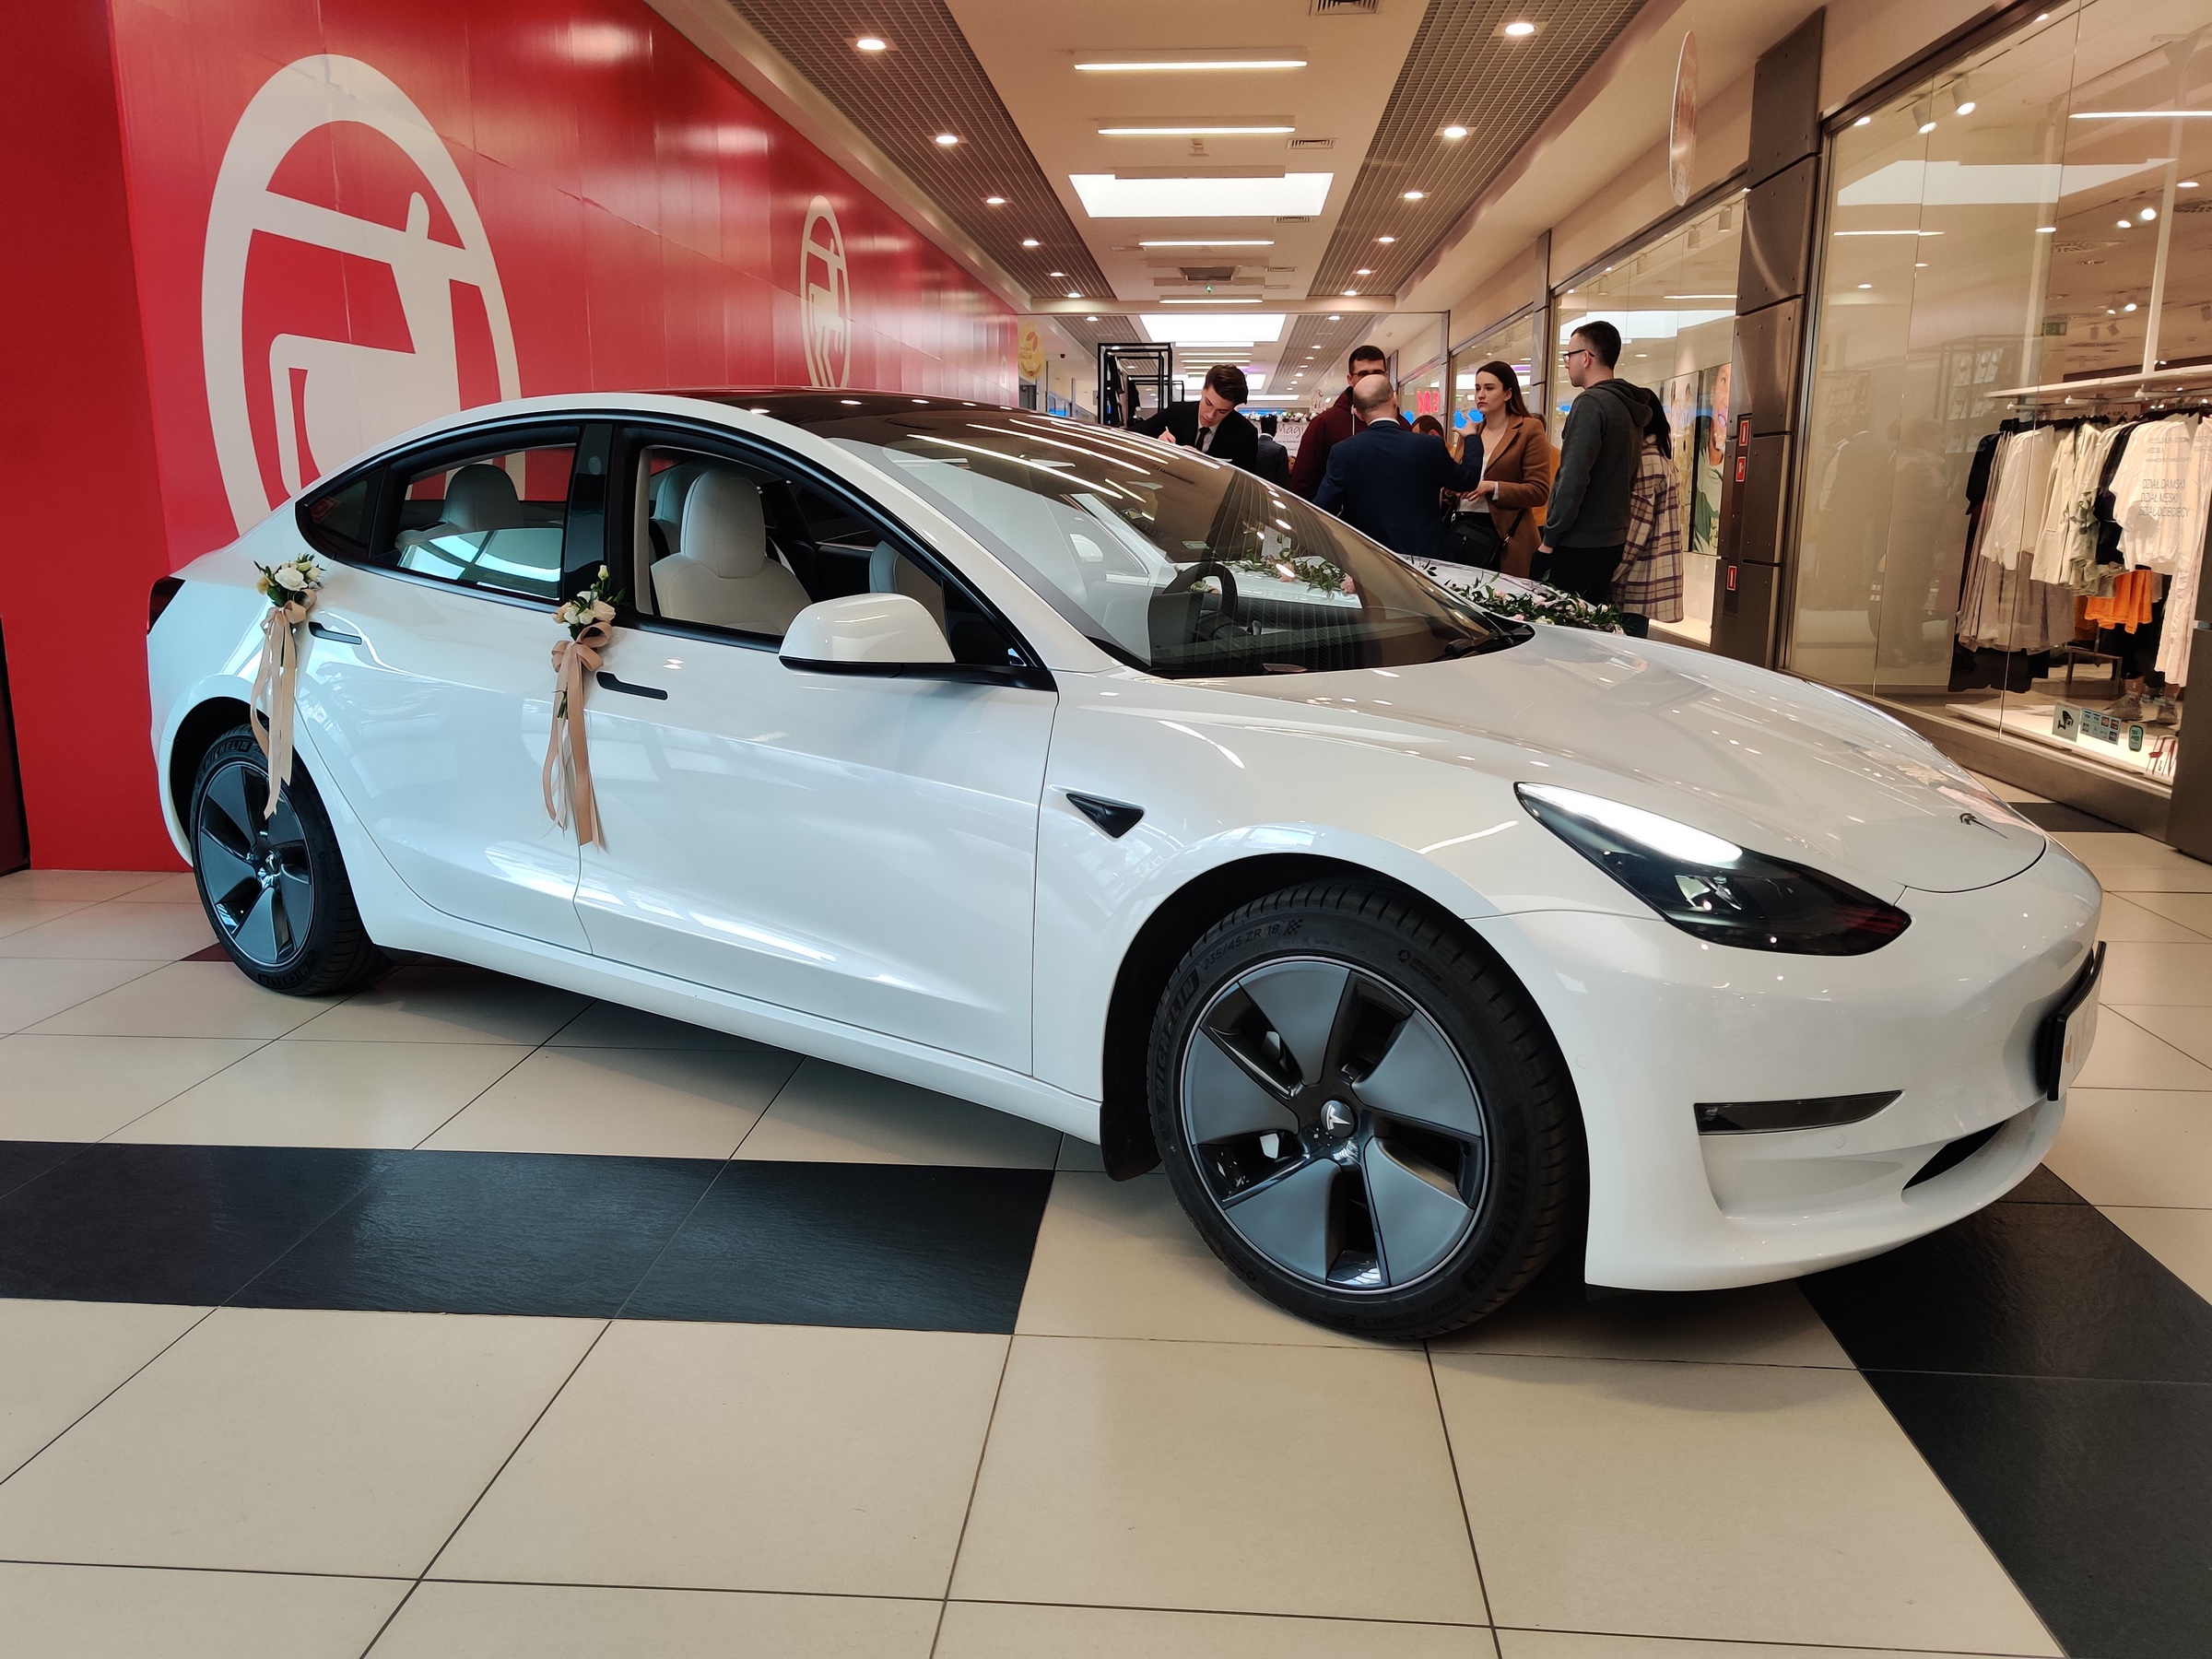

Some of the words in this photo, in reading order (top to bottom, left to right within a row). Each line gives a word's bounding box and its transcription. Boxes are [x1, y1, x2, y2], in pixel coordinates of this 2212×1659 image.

[2160, 478, 2185, 489] DAMSKI
[205, 740, 251, 771] MICHELIN
[1203, 935, 1242, 971] 235/45
[1245, 928, 1263, 943] ZR
[1267, 924, 1280, 935] 18
[1156, 975, 1196, 1105] MICHELIN
